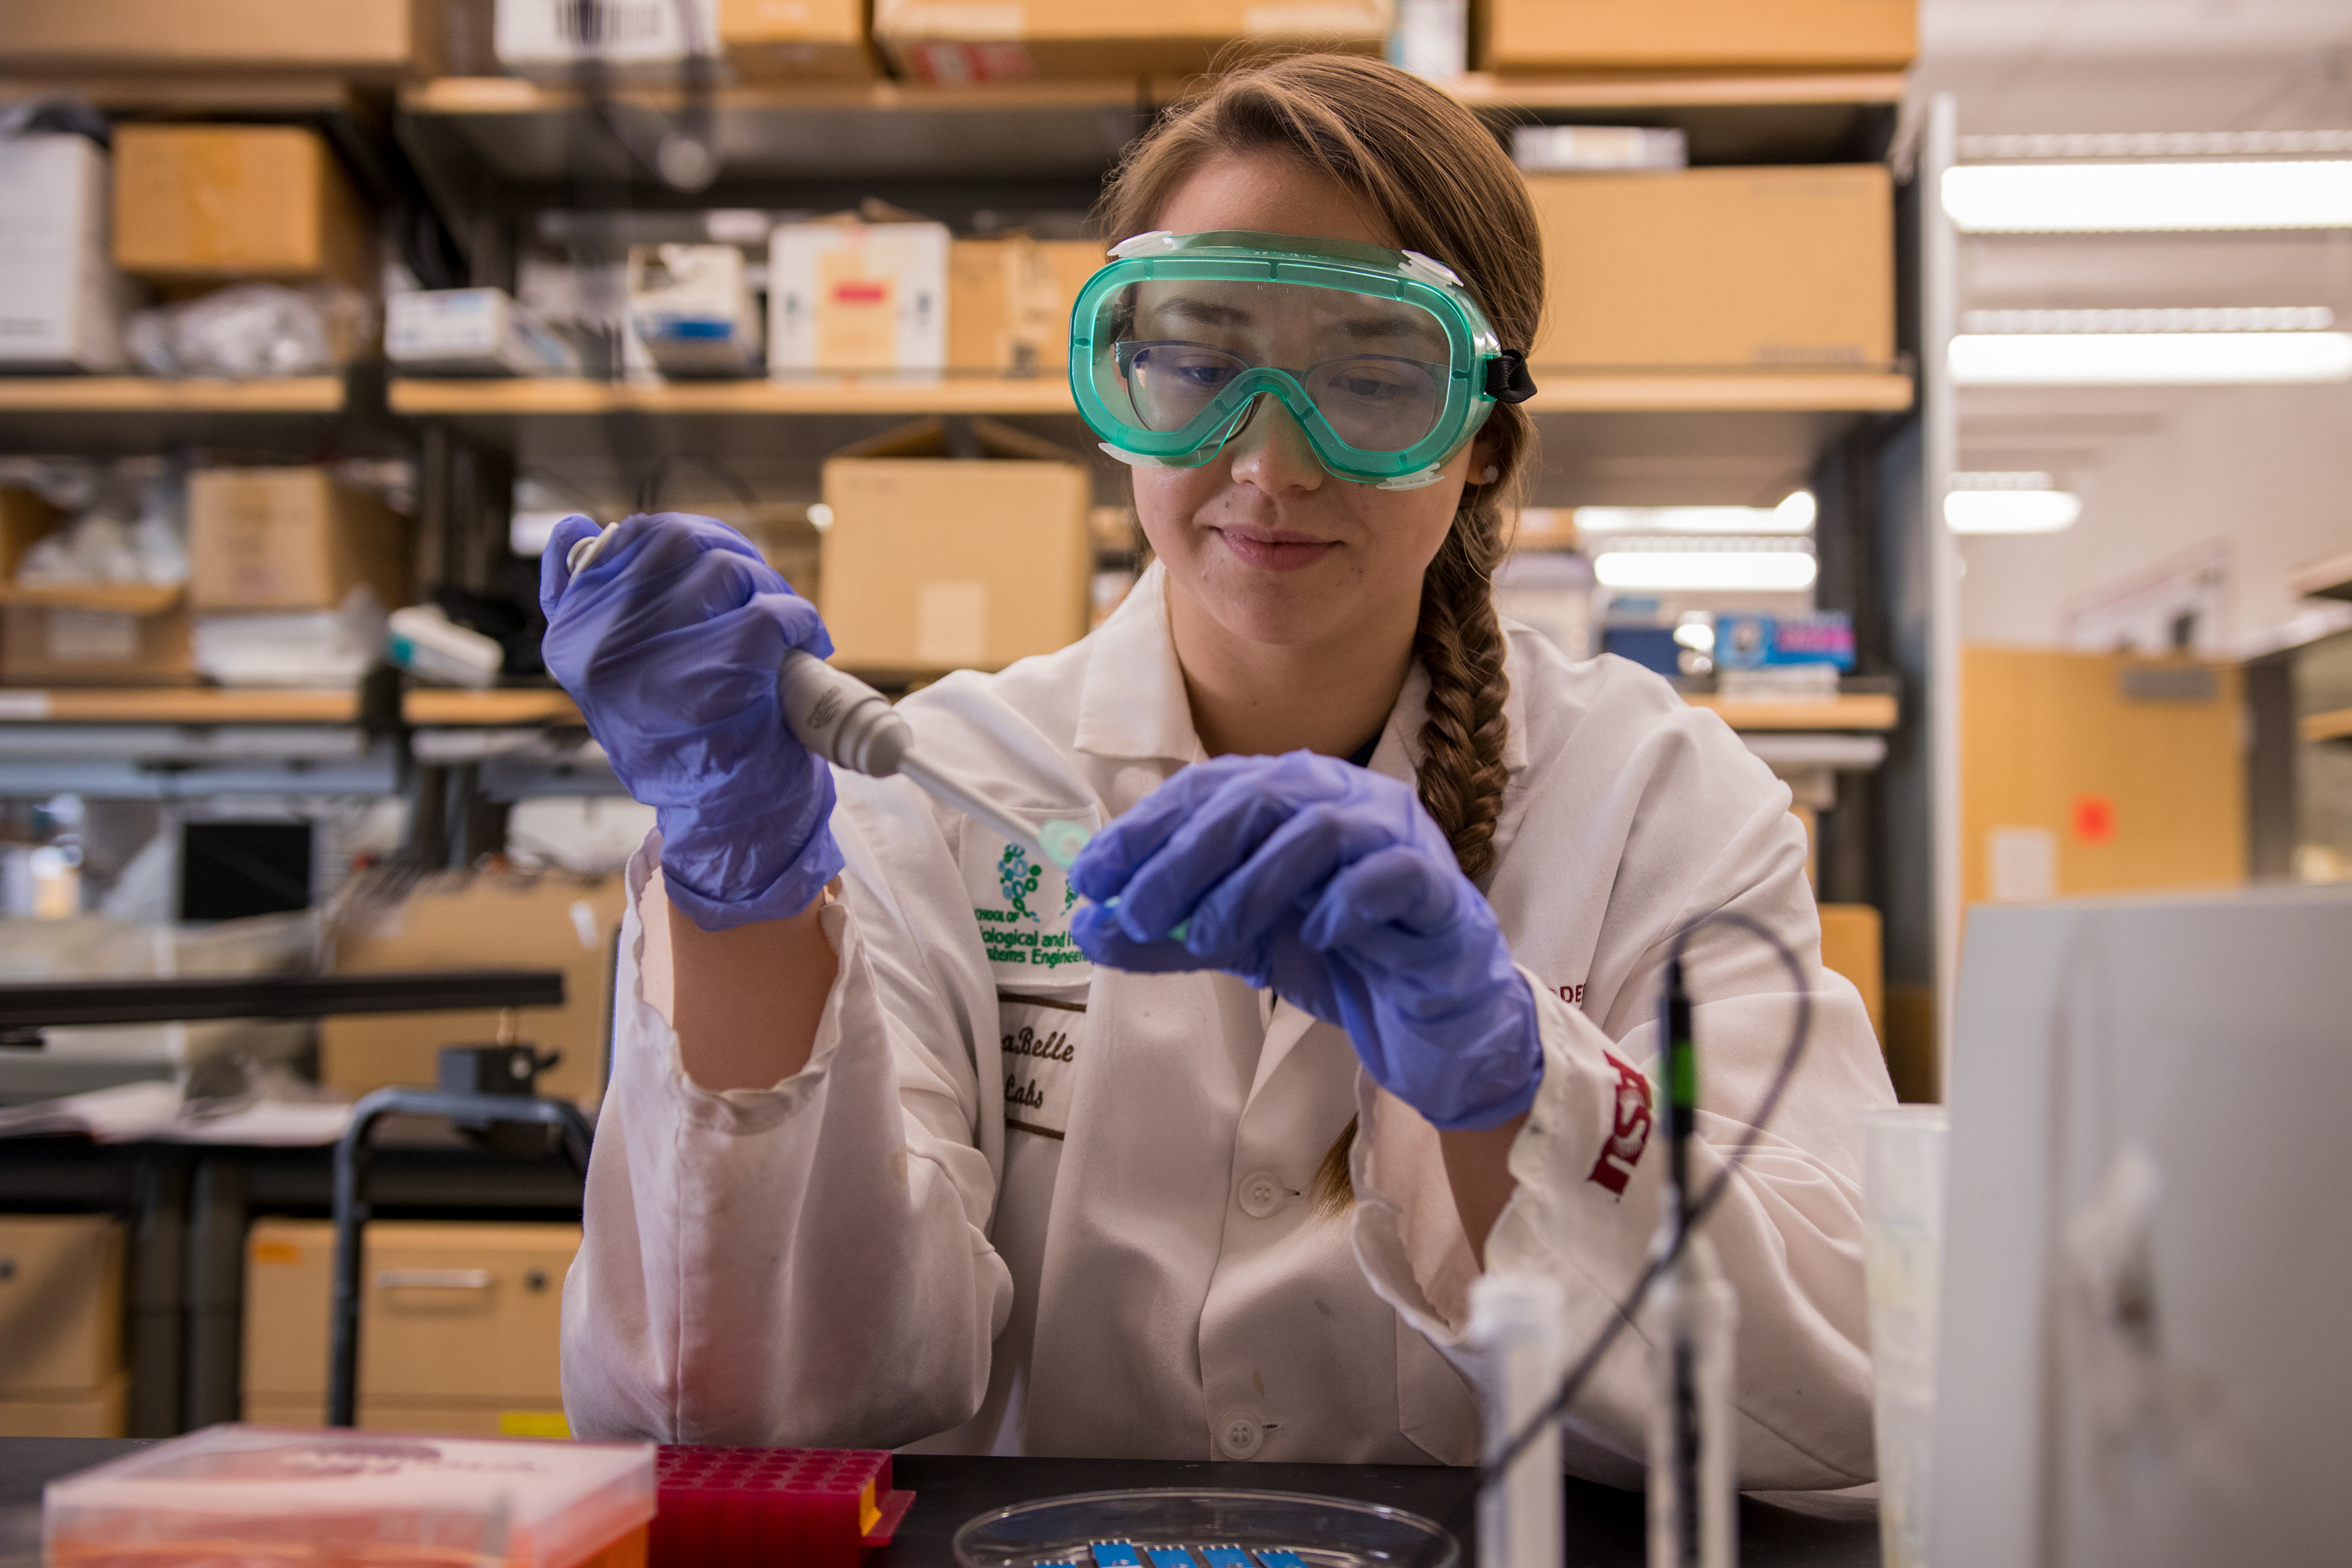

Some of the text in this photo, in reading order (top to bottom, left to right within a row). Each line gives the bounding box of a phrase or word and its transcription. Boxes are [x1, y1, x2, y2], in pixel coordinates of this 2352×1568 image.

[1006, 911, 1019, 923] OF
[979, 925, 1038, 948] ological
[1041, 930, 1066, 948] and
[986, 944, 1026, 963] stems
[1001, 1026, 1074, 1063] aBelle
